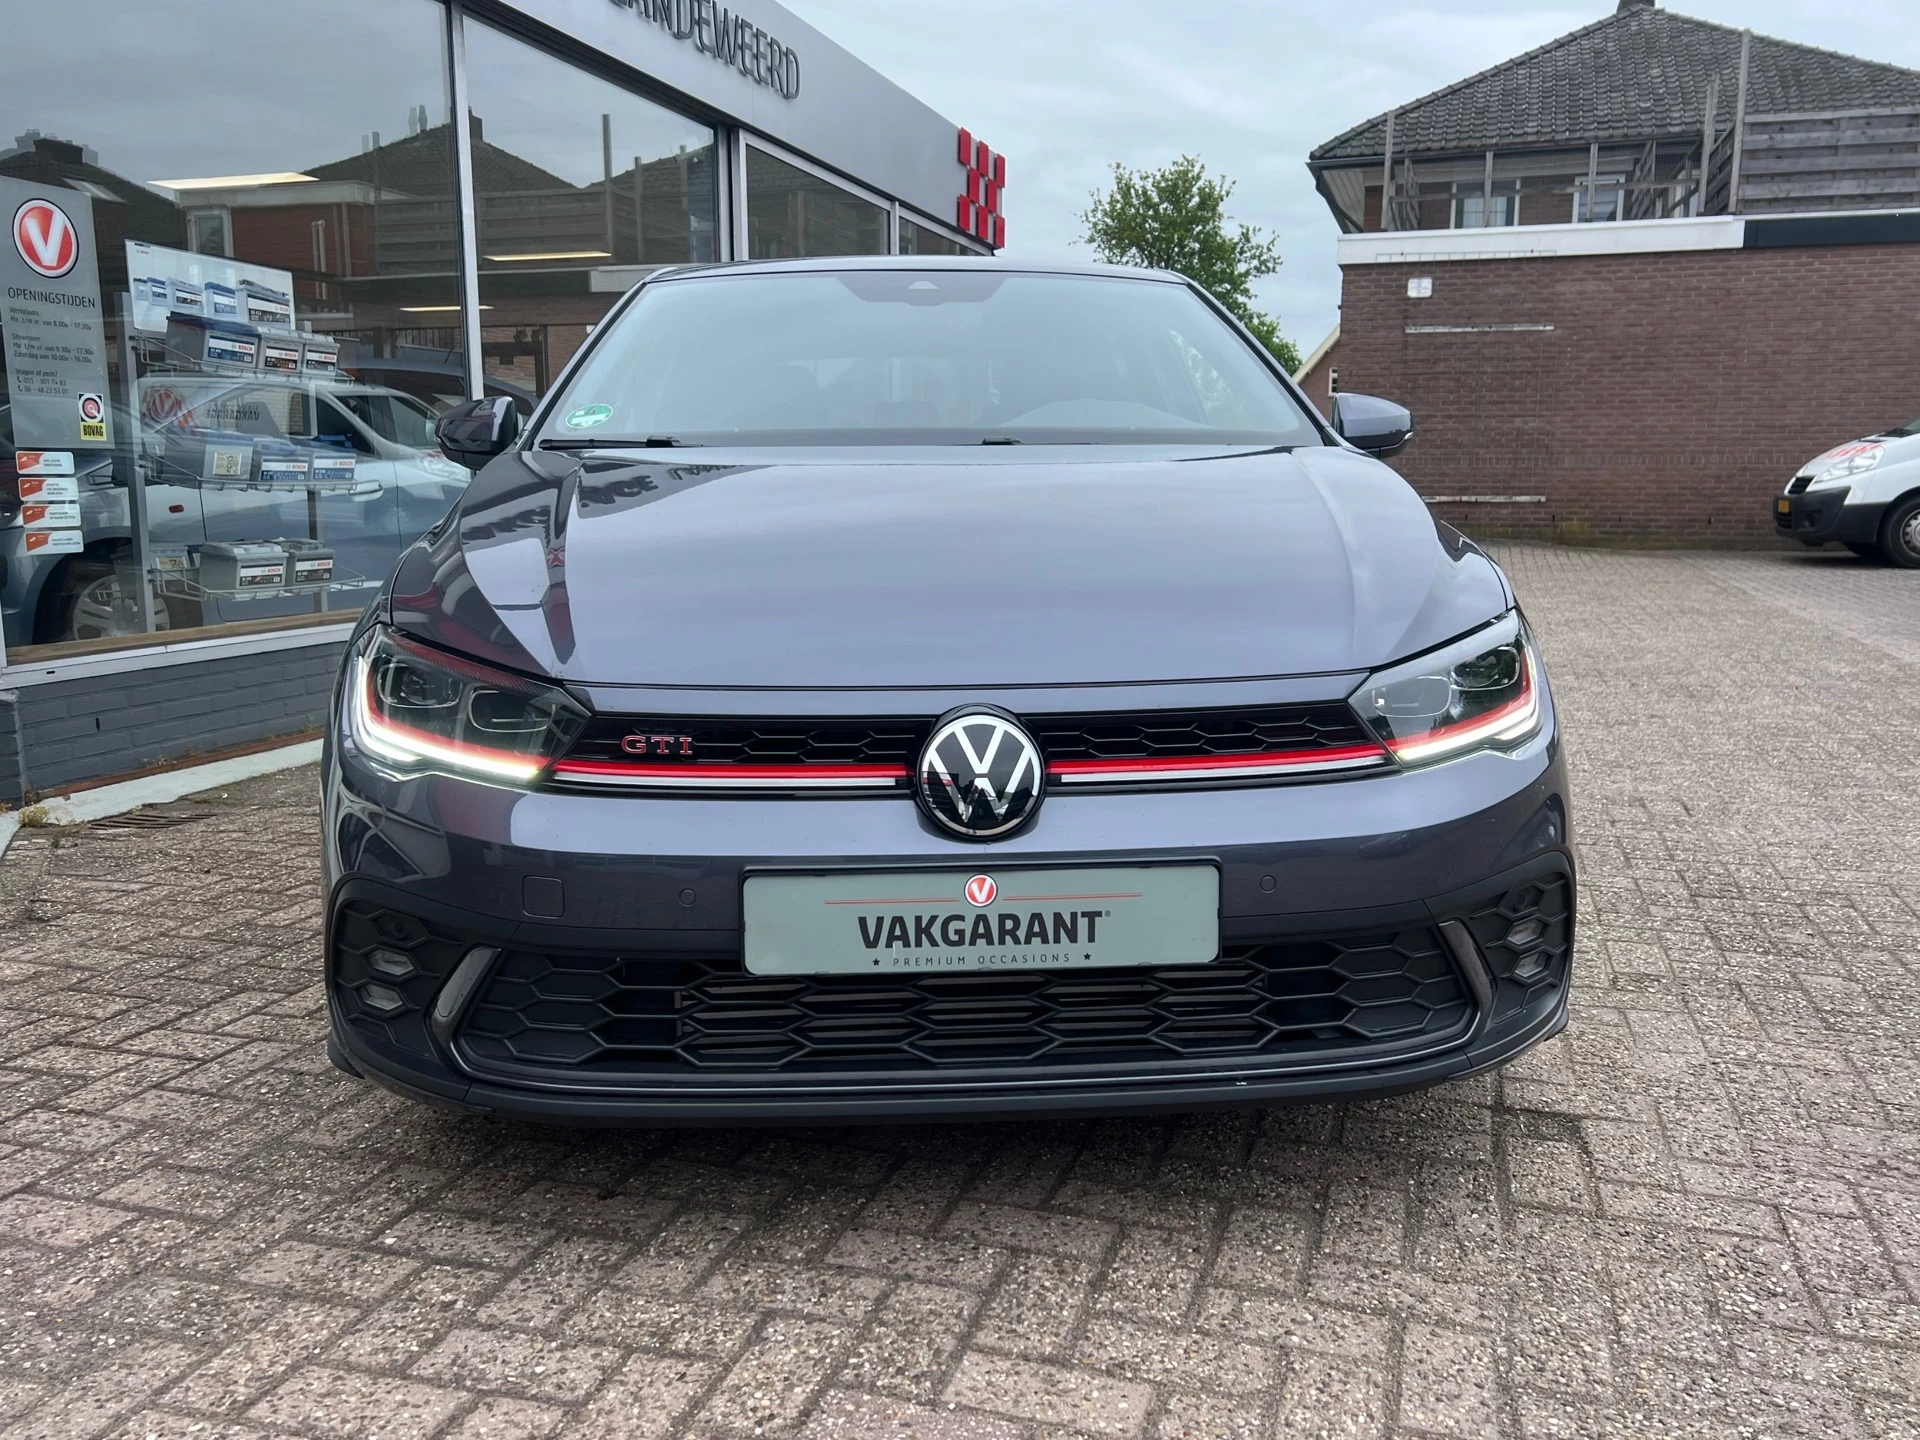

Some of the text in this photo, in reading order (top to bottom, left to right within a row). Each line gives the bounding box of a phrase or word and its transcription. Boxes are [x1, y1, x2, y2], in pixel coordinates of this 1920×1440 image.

[7, 286, 96, 309] OPENINGSTIJDEN
[238, 344, 253, 352] BOSCH
[83, 424, 104, 437] BOVAG
[621, 735, 693, 755] GTI
[893, 953, 1070, 967] PREMIUM OCCASIONS
